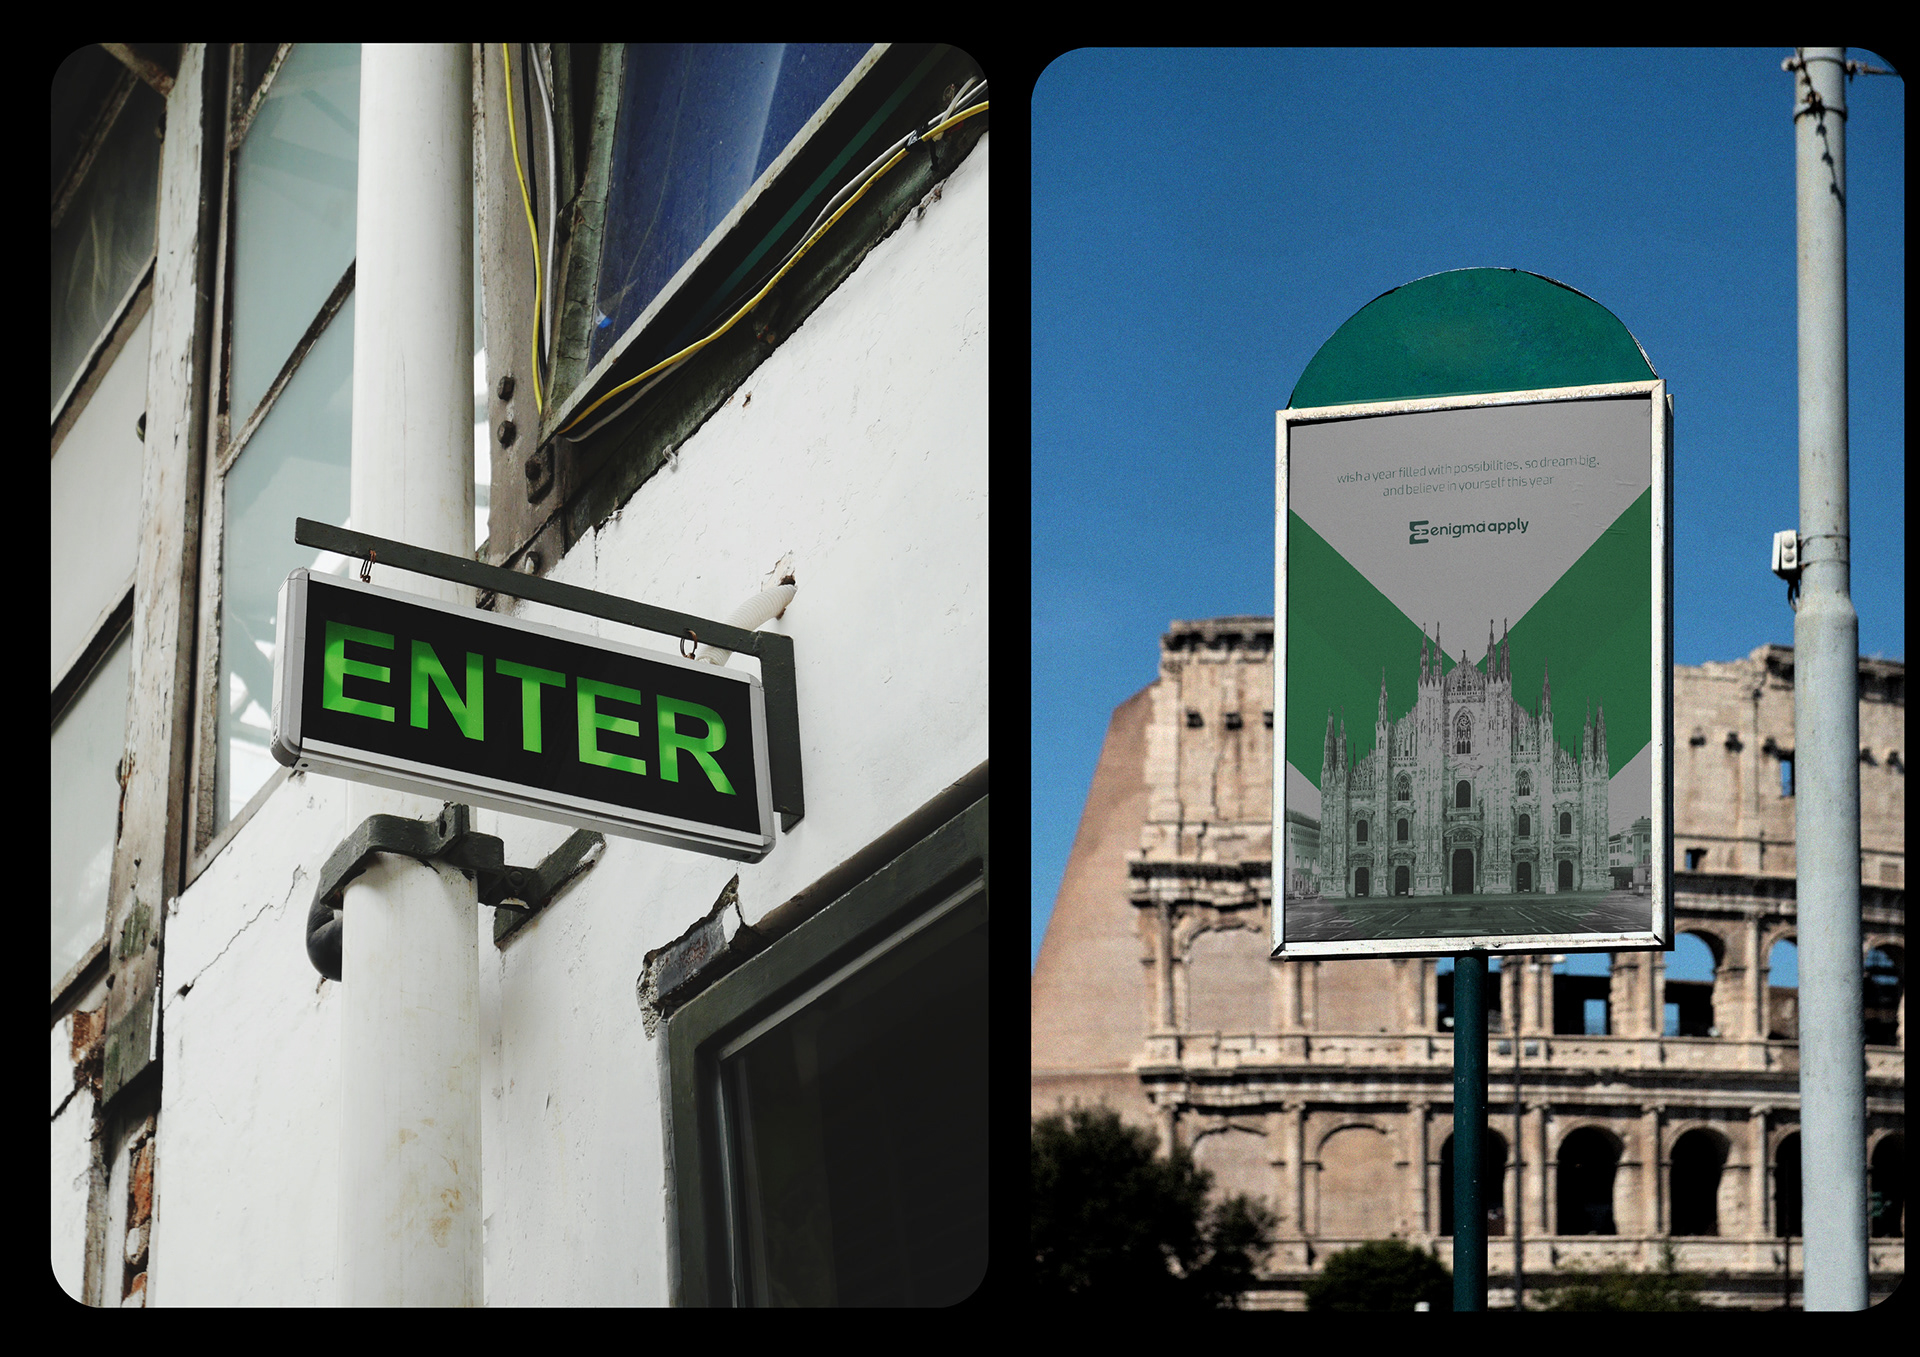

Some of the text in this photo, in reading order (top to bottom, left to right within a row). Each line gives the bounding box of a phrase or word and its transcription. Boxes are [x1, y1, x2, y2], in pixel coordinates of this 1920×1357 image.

[1337, 471, 1362, 483] wish
[1363, 473, 1370, 481] a
[1372, 470, 1397, 482] year
[1399, 466, 1427, 478] filled
[1428, 464, 1452, 476] with
[1525, 459, 1538, 469] so
[1540, 456, 1577, 468] dream
[1383, 476, 1554, 496] and believe in yourself this year
[1430, 521, 1486, 538] enigma
[1488, 517, 1529, 534] apply
[322, 620, 737, 796] ENTER
